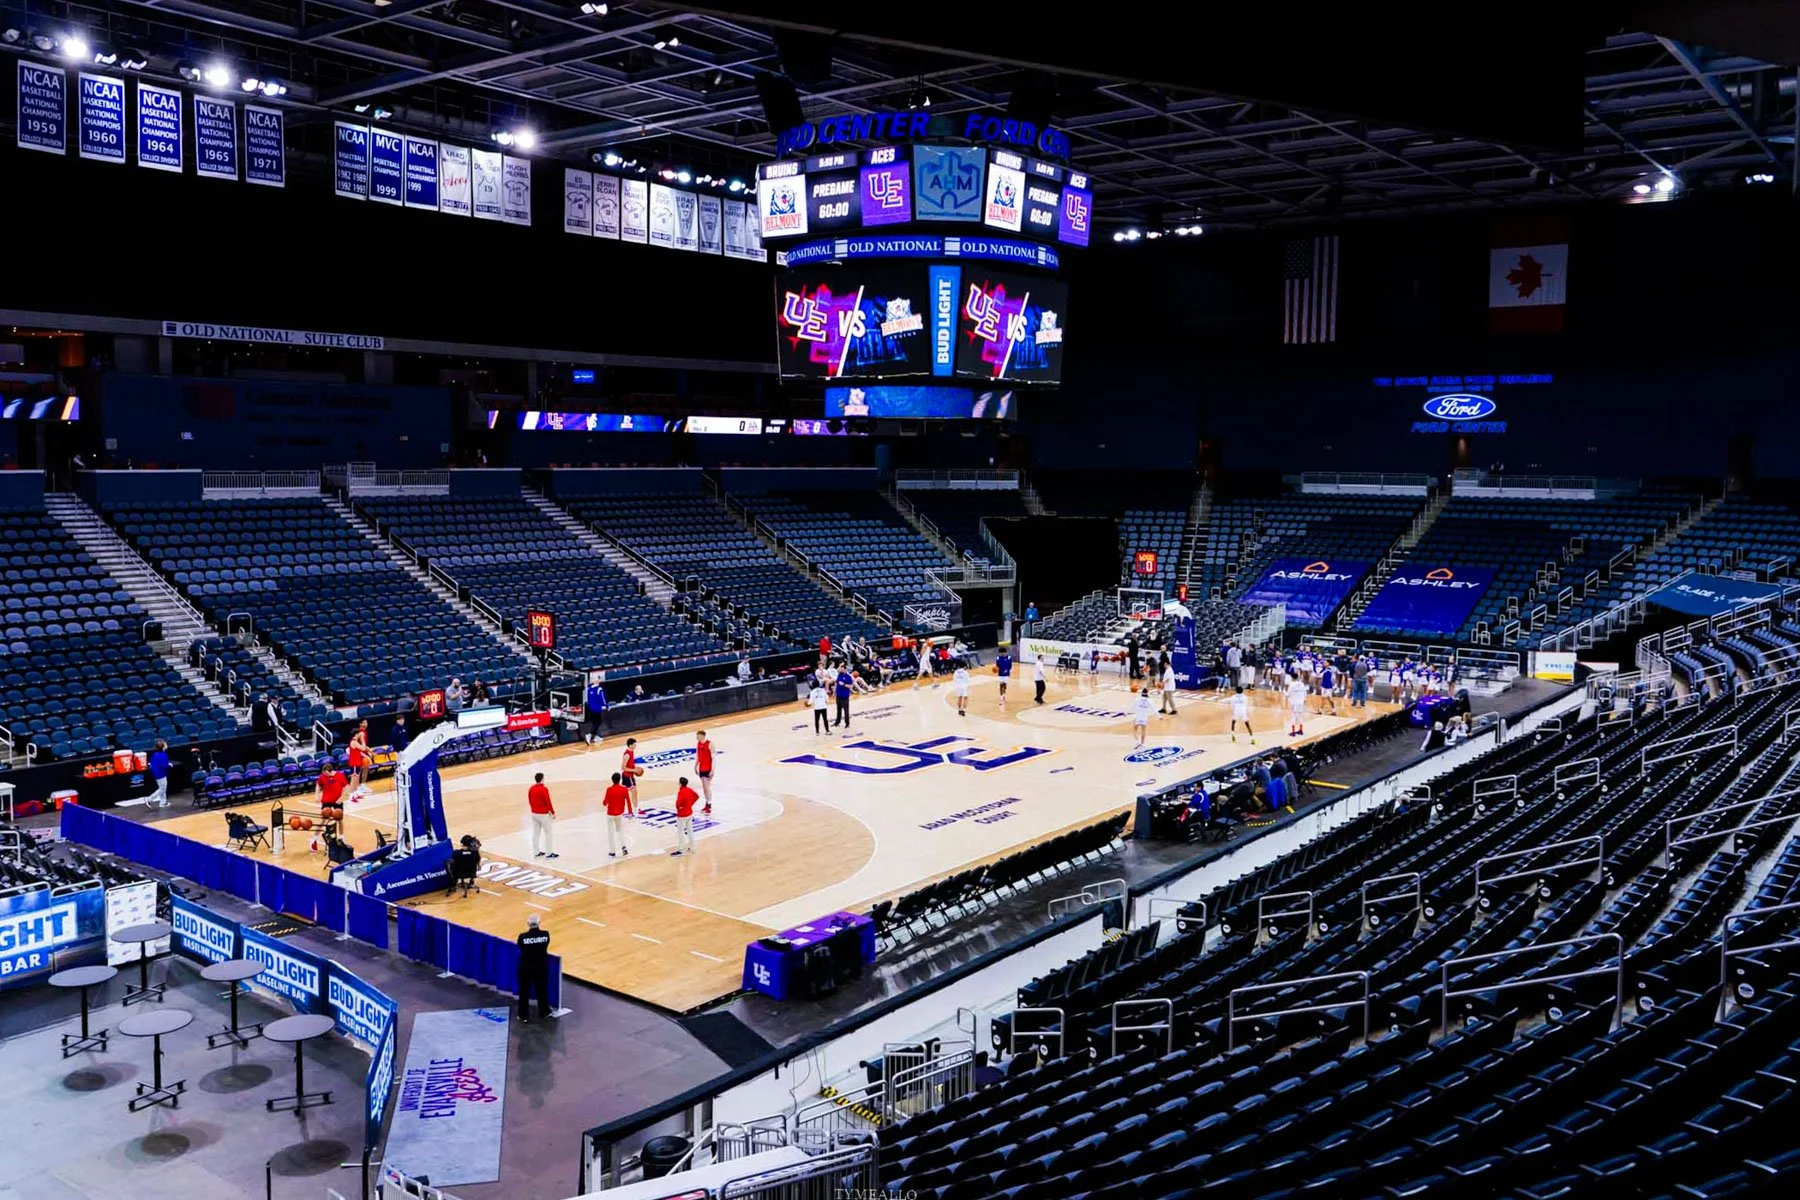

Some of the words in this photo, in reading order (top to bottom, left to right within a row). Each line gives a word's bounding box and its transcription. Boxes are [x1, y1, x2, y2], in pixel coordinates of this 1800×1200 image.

[24, 68, 60, 89] NCAA
[22, 85, 62, 100] BASKETBALL
[84, 81, 120, 100] NCAA
[25, 97, 59, 110] NATIONAL
[83, 96, 121, 111] BASKETBALL
[143, 91, 176, 112] NCAA
[22, 106, 61, 120] CHAMPIONS
[86, 108, 119, 121] NATIONAL
[141, 106, 178, 121] BASKETBALL
[200, 102, 230, 120] NCAA
[28, 120, 56, 134] 1959
[83, 117, 121, 130] CHAMPIONS
[144, 118, 176, 130] NATIONAL
[198, 118, 232, 130] BASKETBALL
[249, 112, 278, 129] NCAA
[818, 111, 931, 144] CENTER
[964, 113, 1037, 145] FORD
[88, 130, 116, 144] 1960
[142, 127, 178, 140] CHAMPIONS
[201, 128, 230, 138] NATIONAL
[248, 126, 280, 138] BASKETBALL
[338, 128, 365, 146] NCAA
[147, 140, 174, 154] 1964
[200, 136, 232, 148] CHAMPIONS
[250, 137, 278, 147] NATIONAL
[376, 134, 399, 152] MVC
[409, 142, 434, 158] NCAA
[205, 149, 229, 162] 1965
[248, 146, 280, 157] CHAMPIONS
[870, 148, 896, 164] ACES
[254, 158, 276, 170] 1971
[408, 164, 435, 174] BASKETBALL
[766, 162, 798, 179] BRUINS
[407, 172, 436, 183] TOURNAMENT
[930, 175, 972, 191] AHM
[1070, 174, 1087, 189] ACES
[376, 184, 396, 196] 1999
[408, 181, 422, 192] 1999
[813, 180, 855, 198] PREGAME
[868, 172, 904, 208] UE
[1028, 187, 1060, 206] PREGAME
[819, 202, 849, 219] 60:00
[1066, 193, 1088, 232] UE
[764, 213, 802, 231] BELMONT
[796, 244, 832, 260] NATIONAL
[849, 242, 874, 252] OLD
[877, 241, 941, 252] NATIONAL
[962, 242, 988, 253] OLD
[990, 244, 1037, 259] NATIONAL
[938, 279, 952, 326] LIGHT
[783, 291, 828, 343] UE
[965, 283, 1000, 342] UE
[838, 309, 866, 338] VS
[1006, 312, 1028, 342] VS
[182, 324, 214, 336] OLD
[218, 326, 292, 342] NATIONAL
[304, 333, 344, 346] SUITE
[346, 336, 382, 349] CLUB
[936, 328, 950, 364] BUD
[1437, 398, 1482, 416] Ford
[1411, 422, 1448, 432] FORD
[1451, 421, 1506, 432] CENTER
[1270, 570, 1352, 581] ASHLEY
[1390, 577, 1480, 588] ASHLEY
[541, 627, 550, 644] 0
[1174, 672, 1190, 682] eijer
[430, 702, 438, 714] 0
[770, 735, 1060, 775] UE
[386, 876, 416, 890] Ascension
[416, 874, 424, 882] St.
[424, 870, 447, 881] Vincent
[0, 910, 69, 951] GHT
[174, 912, 198, 934] BUD
[200, 926, 232, 955] LIGHT
[183, 938, 210, 958] BASELINE
[523, 936, 548, 944] SECURITY
[1, 954, 41, 976] BAR
[246, 945, 274, 970] BUD
[276, 964, 316, 988] LIGHT
[753, 962, 771, 986] UE
[256, 974, 289, 993] BASELINE
[291, 986, 306, 1003] BAR
[330, 981, 354, 1008] BUD
[355, 1000, 387, 1030] LIGHT
[340, 1011, 366, 1038] BASELINE
[400, 1076, 423, 1112] UNIVERSITY
[420, 1058, 463, 1119] EVANSVILLE
